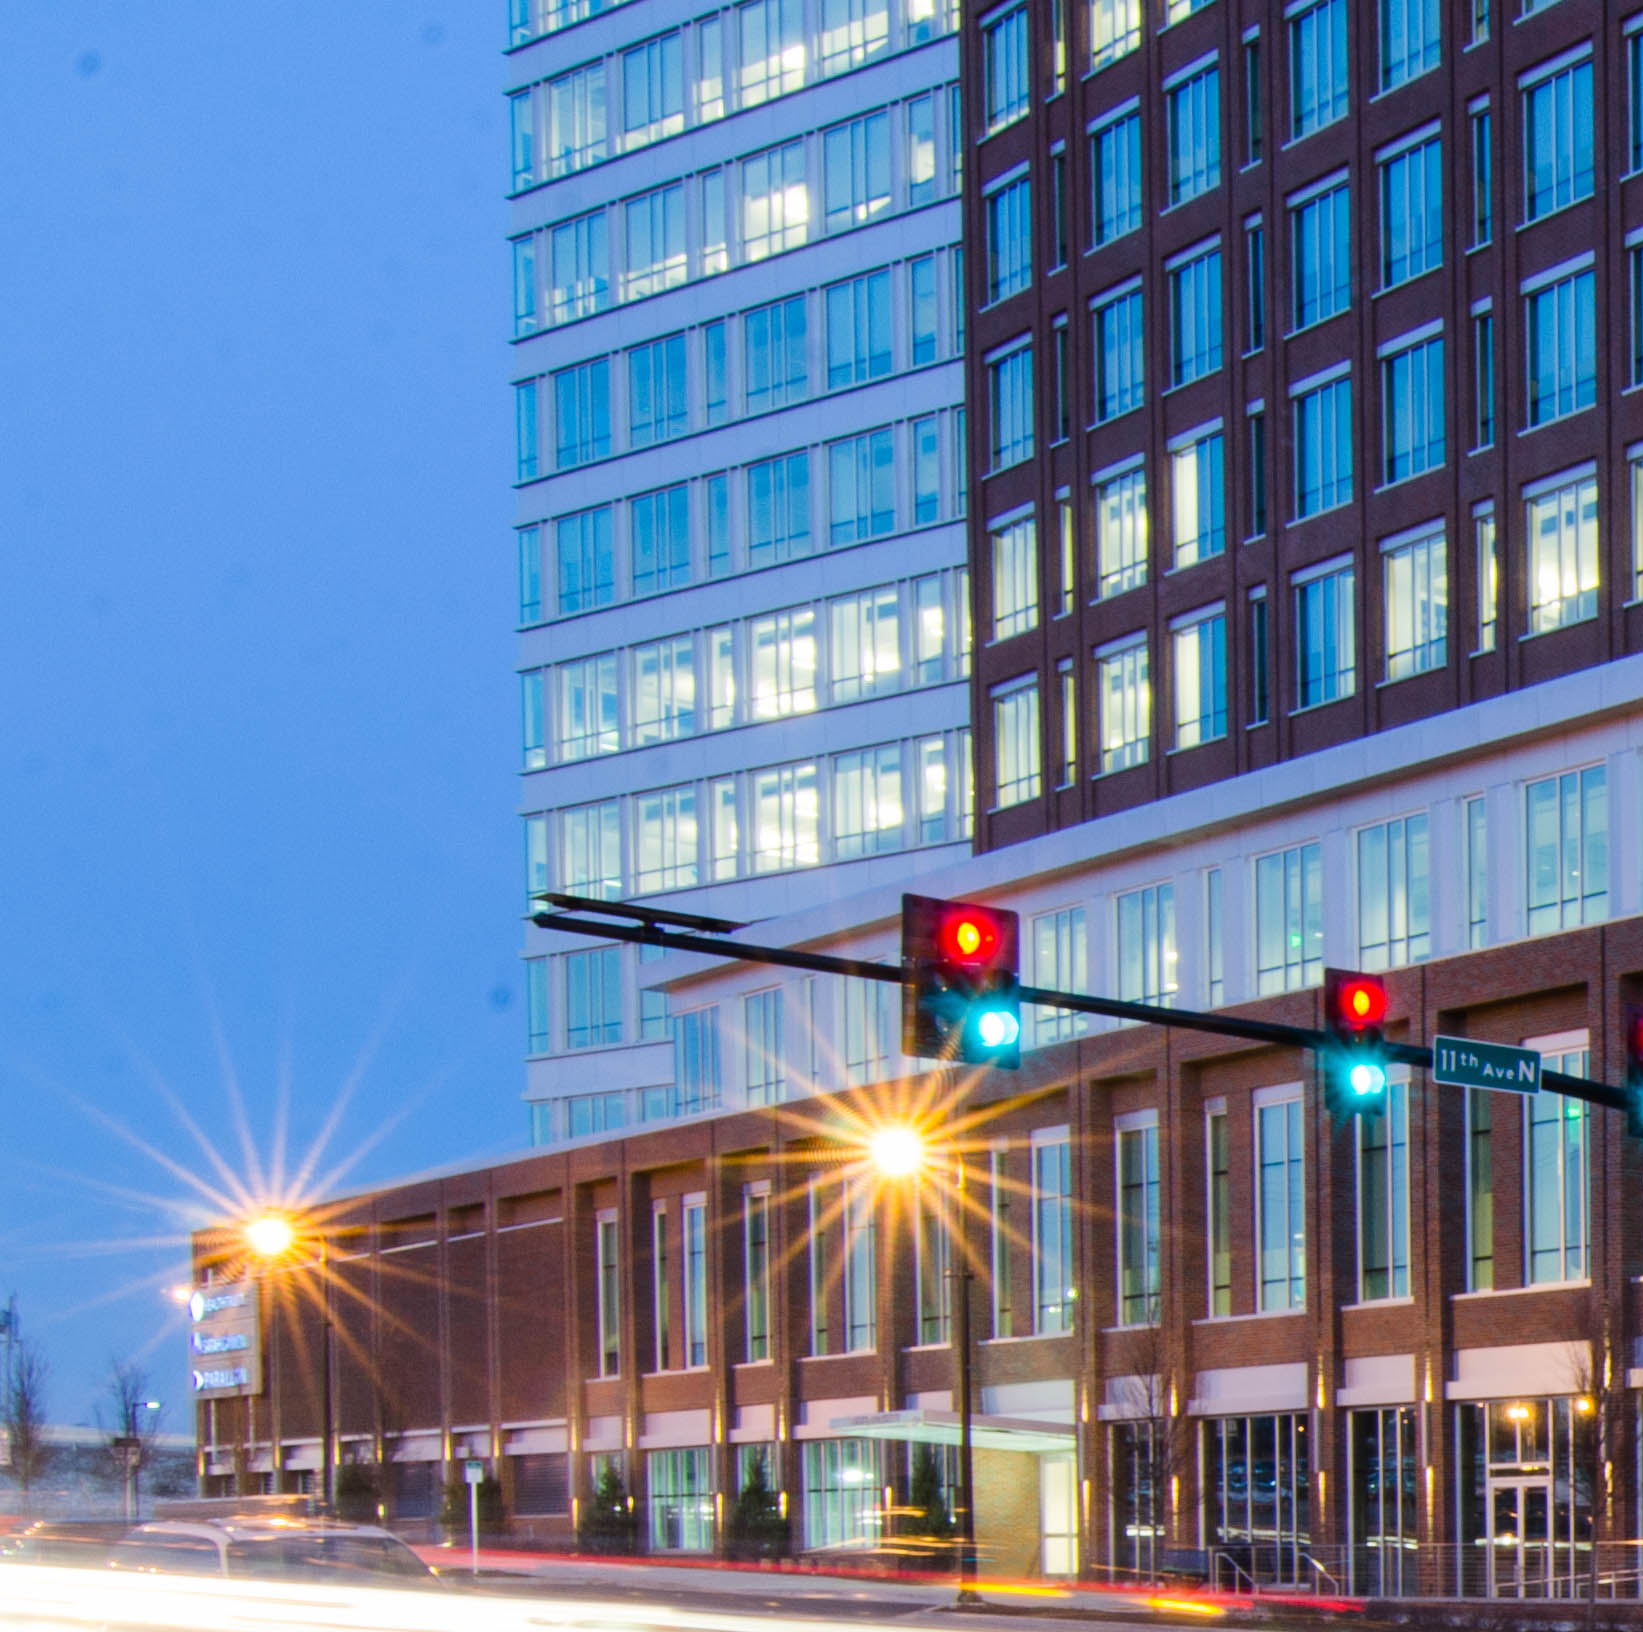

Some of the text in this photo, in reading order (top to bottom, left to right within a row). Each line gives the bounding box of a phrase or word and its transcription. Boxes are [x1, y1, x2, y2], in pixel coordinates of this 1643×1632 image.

[1441, 1049, 1535, 1083] 11th Ave N
